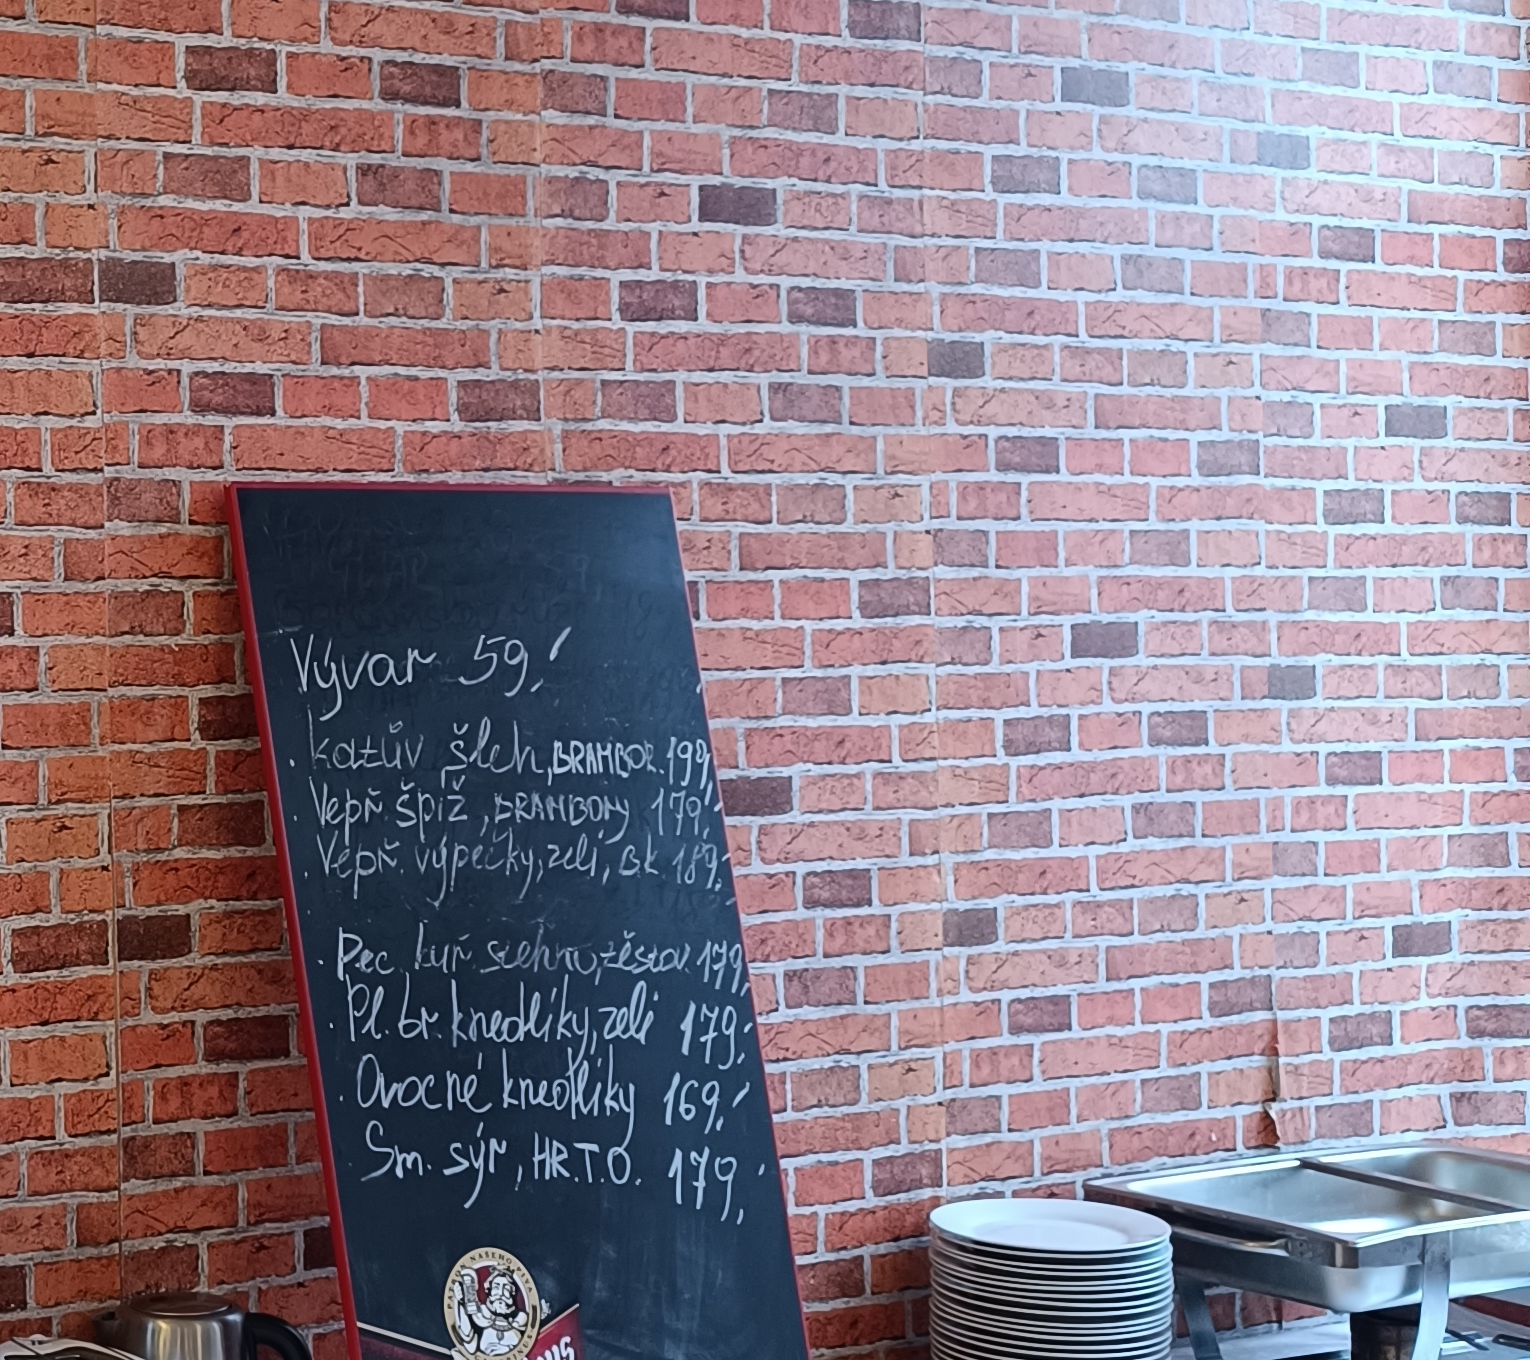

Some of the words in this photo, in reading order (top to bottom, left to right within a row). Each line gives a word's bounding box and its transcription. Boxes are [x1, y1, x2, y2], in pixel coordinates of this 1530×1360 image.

[290, 633, 438, 721] Vývar
[356, 1051, 492, 1113] Ovocné
[502, 1043, 636, 1152] knedlíky
[361, 1119, 432, 1182] Sm.
[469, 1250, 513, 1266] NAŠEHO
[515, 1265, 533, 1294] PIVA
